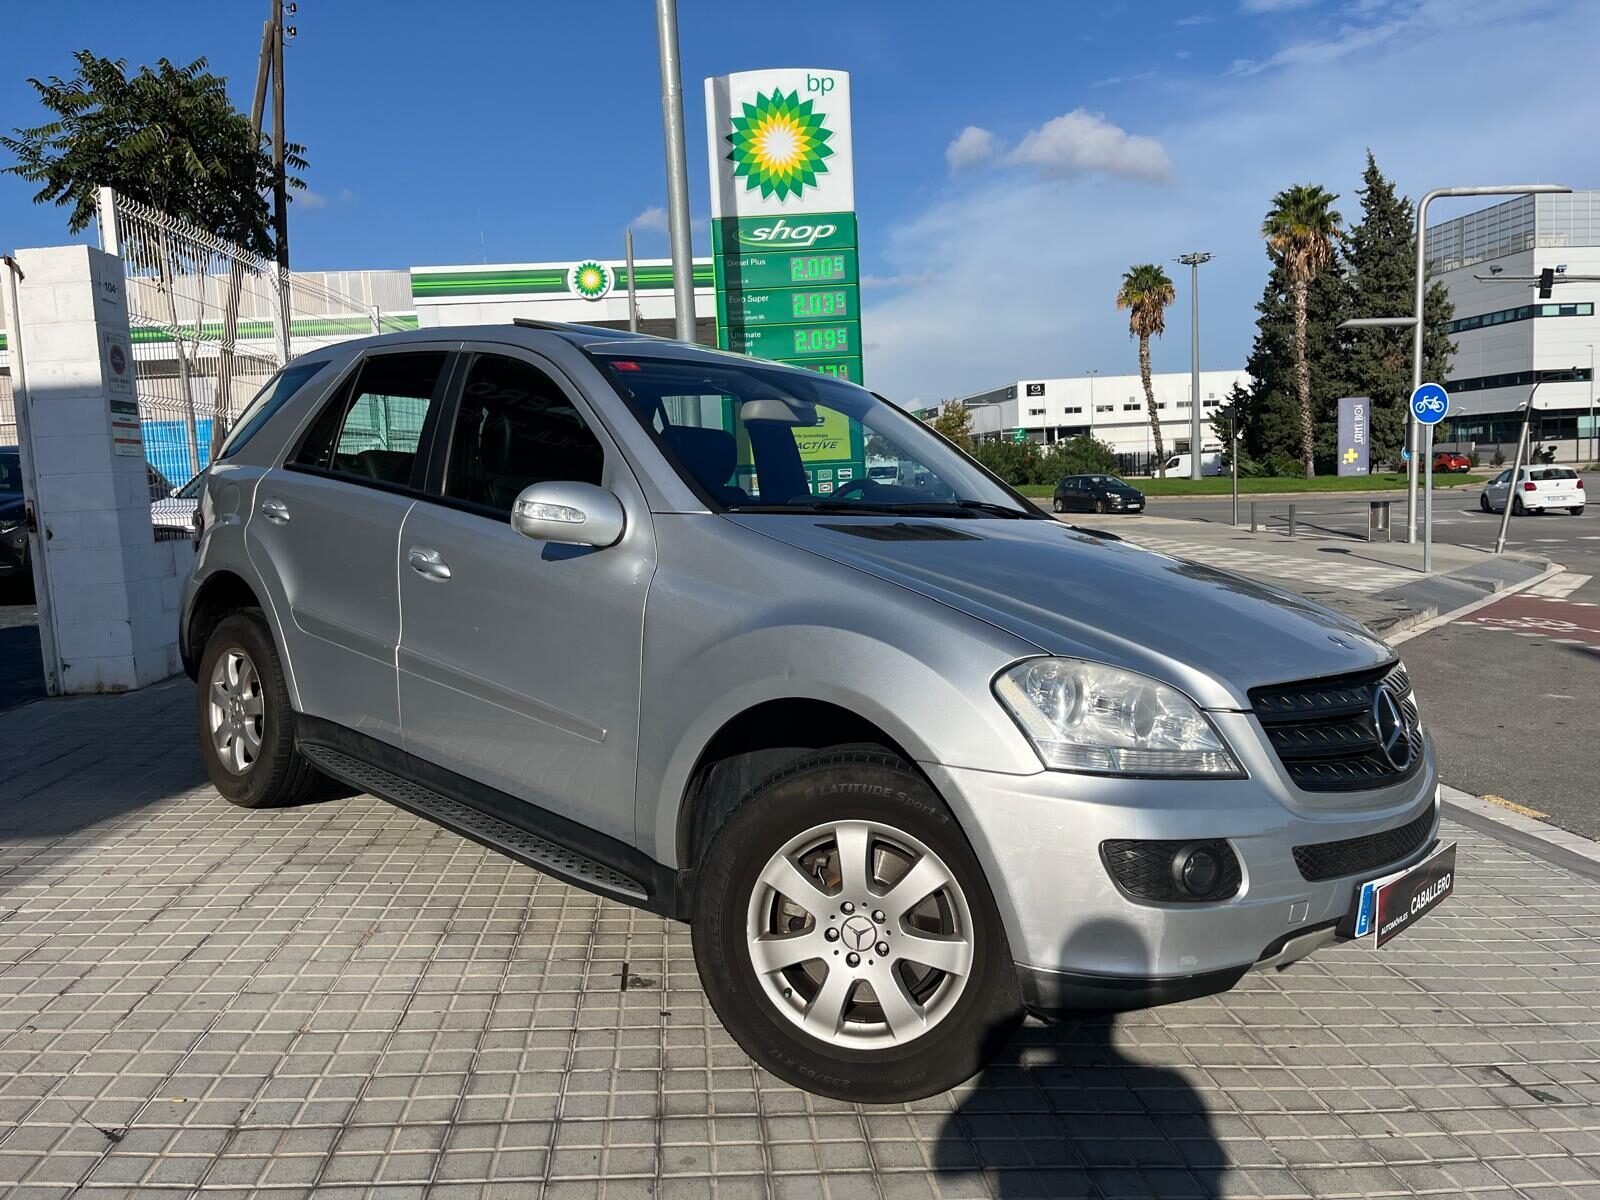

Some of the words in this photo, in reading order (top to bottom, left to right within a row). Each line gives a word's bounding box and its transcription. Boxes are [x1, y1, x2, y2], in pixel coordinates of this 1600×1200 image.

[807, 74, 834, 96] bp
[751, 220, 836, 246] shop
[750, 258, 766, 266] Plus
[792, 257, 843, 279] 2.005
[747, 294, 769, 304] Super
[795, 329, 846, 351] 2.095
[819, 783, 893, 798] LATITUDE
[896, 791, 936, 815] Sport
[937, 814, 949, 824] 3
[1410, 873, 1451, 915] CABALLERO
[1361, 915, 1367, 926] E
